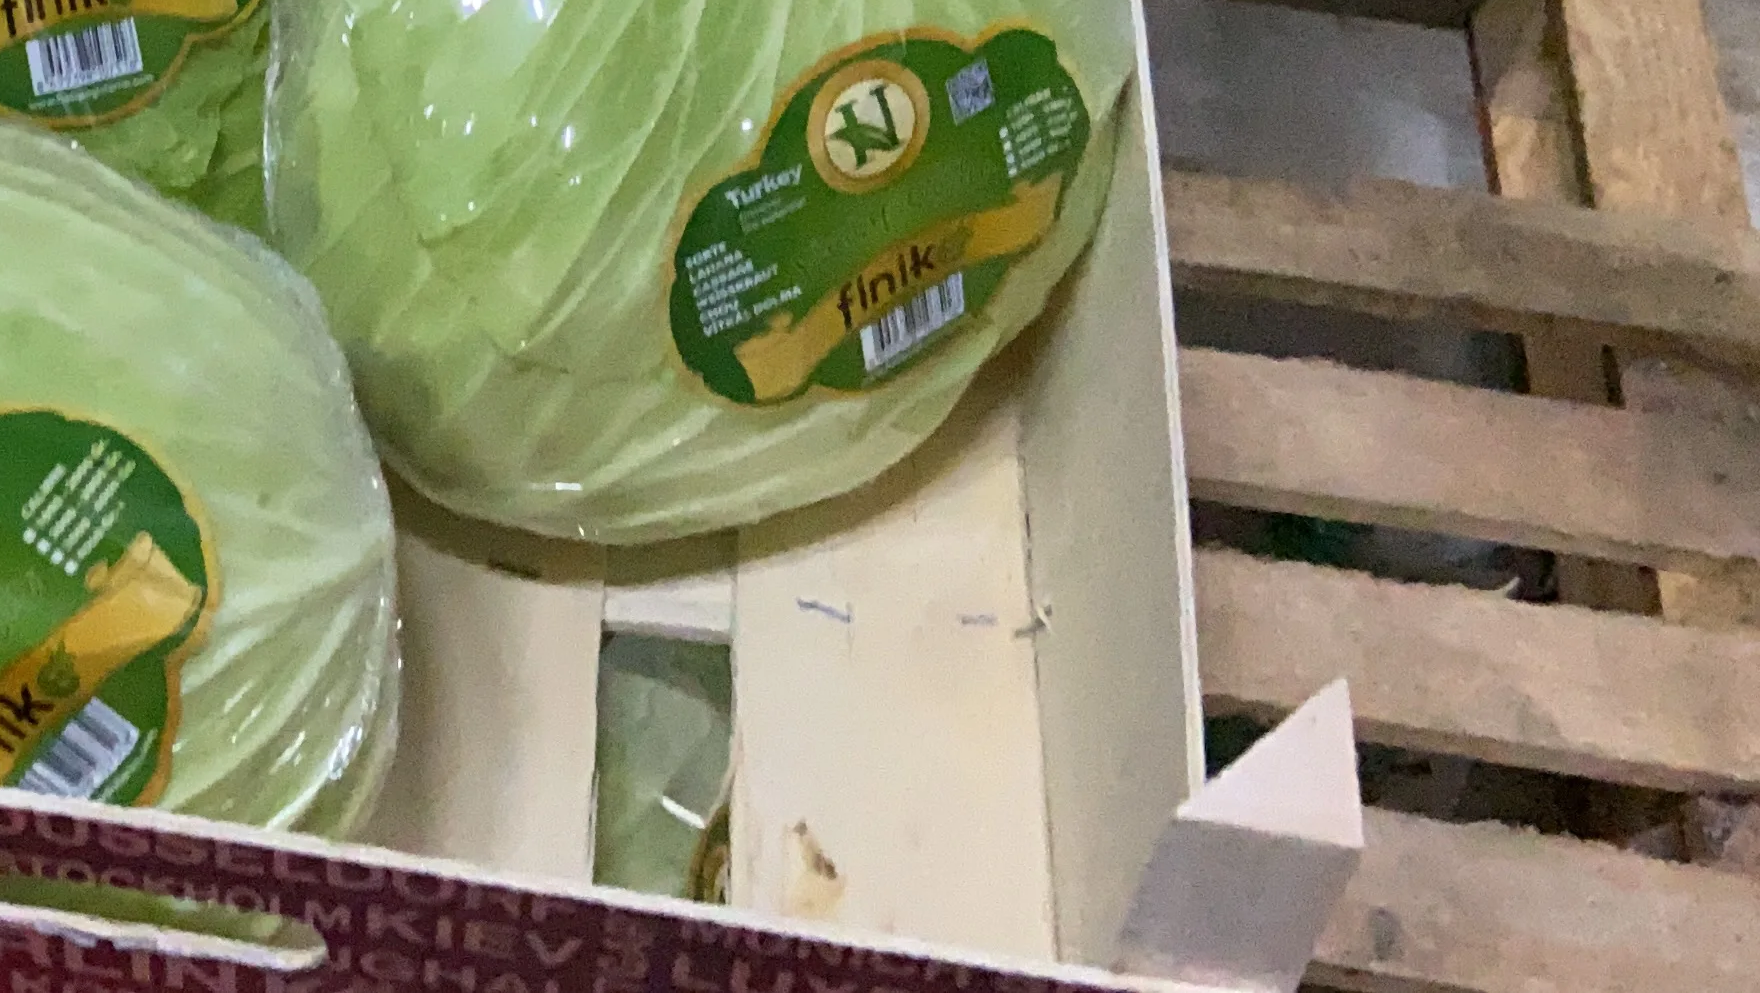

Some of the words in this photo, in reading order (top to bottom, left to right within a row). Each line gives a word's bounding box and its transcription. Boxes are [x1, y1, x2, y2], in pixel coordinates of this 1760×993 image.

[725, 163, 802, 210] Turkey
[837, 243, 937, 330] finik
[367, 906, 585, 965] KIEV
